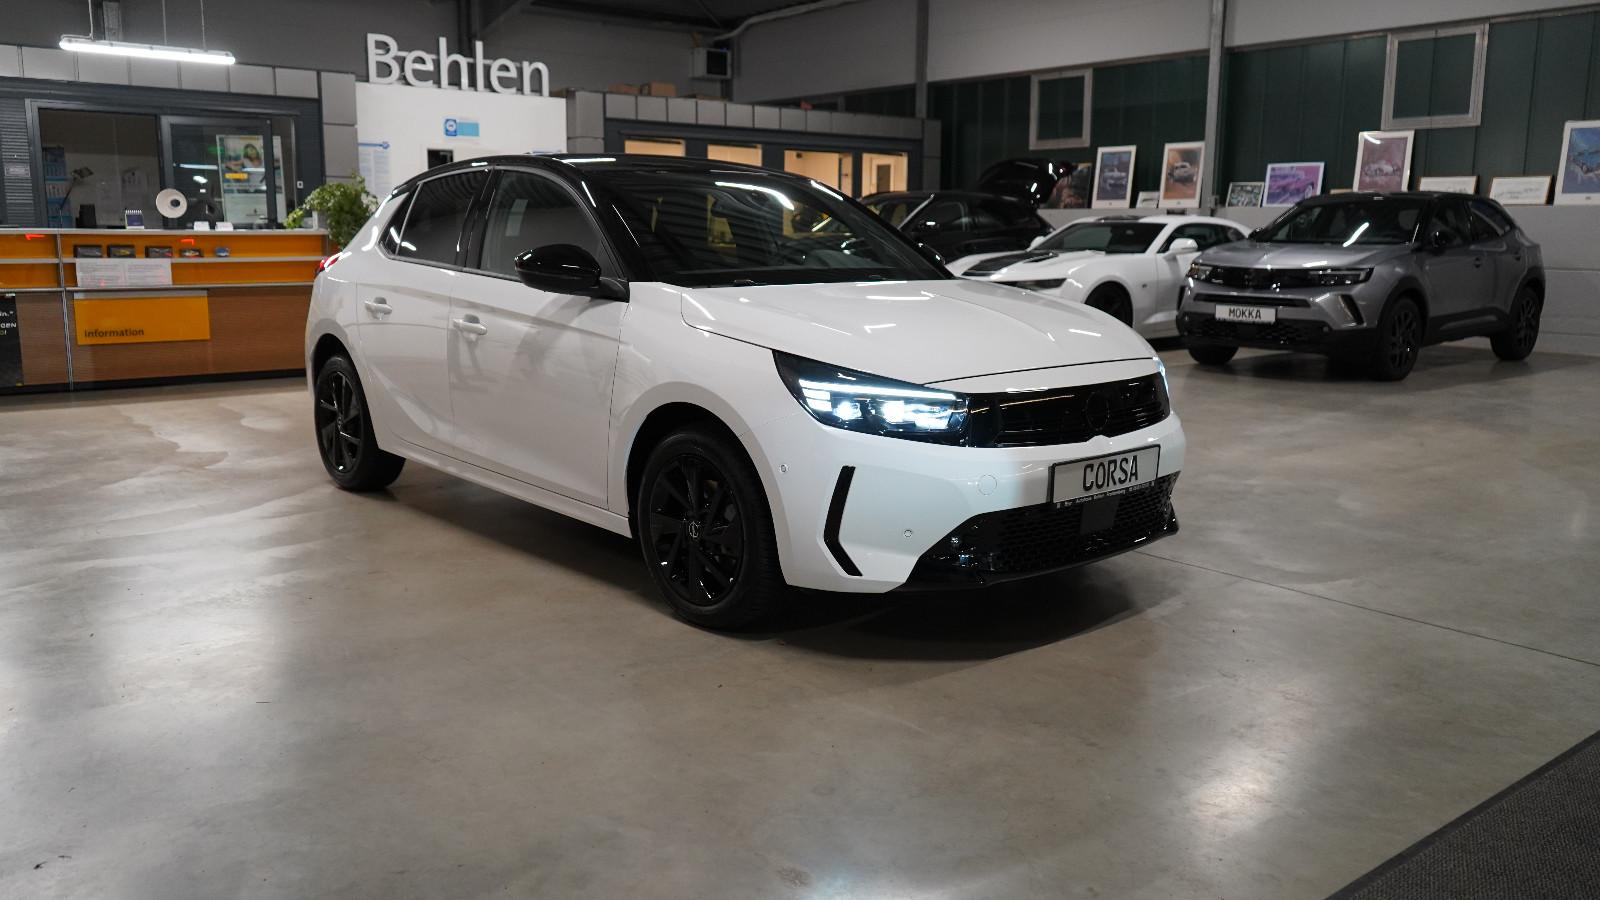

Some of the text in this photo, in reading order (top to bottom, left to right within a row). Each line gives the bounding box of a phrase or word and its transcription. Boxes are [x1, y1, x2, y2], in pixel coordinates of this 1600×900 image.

[367, 33, 549, 97] Behlen
[1228, 307, 1262, 319] MOKKA
[1082, 454, 1139, 492] CORSA
